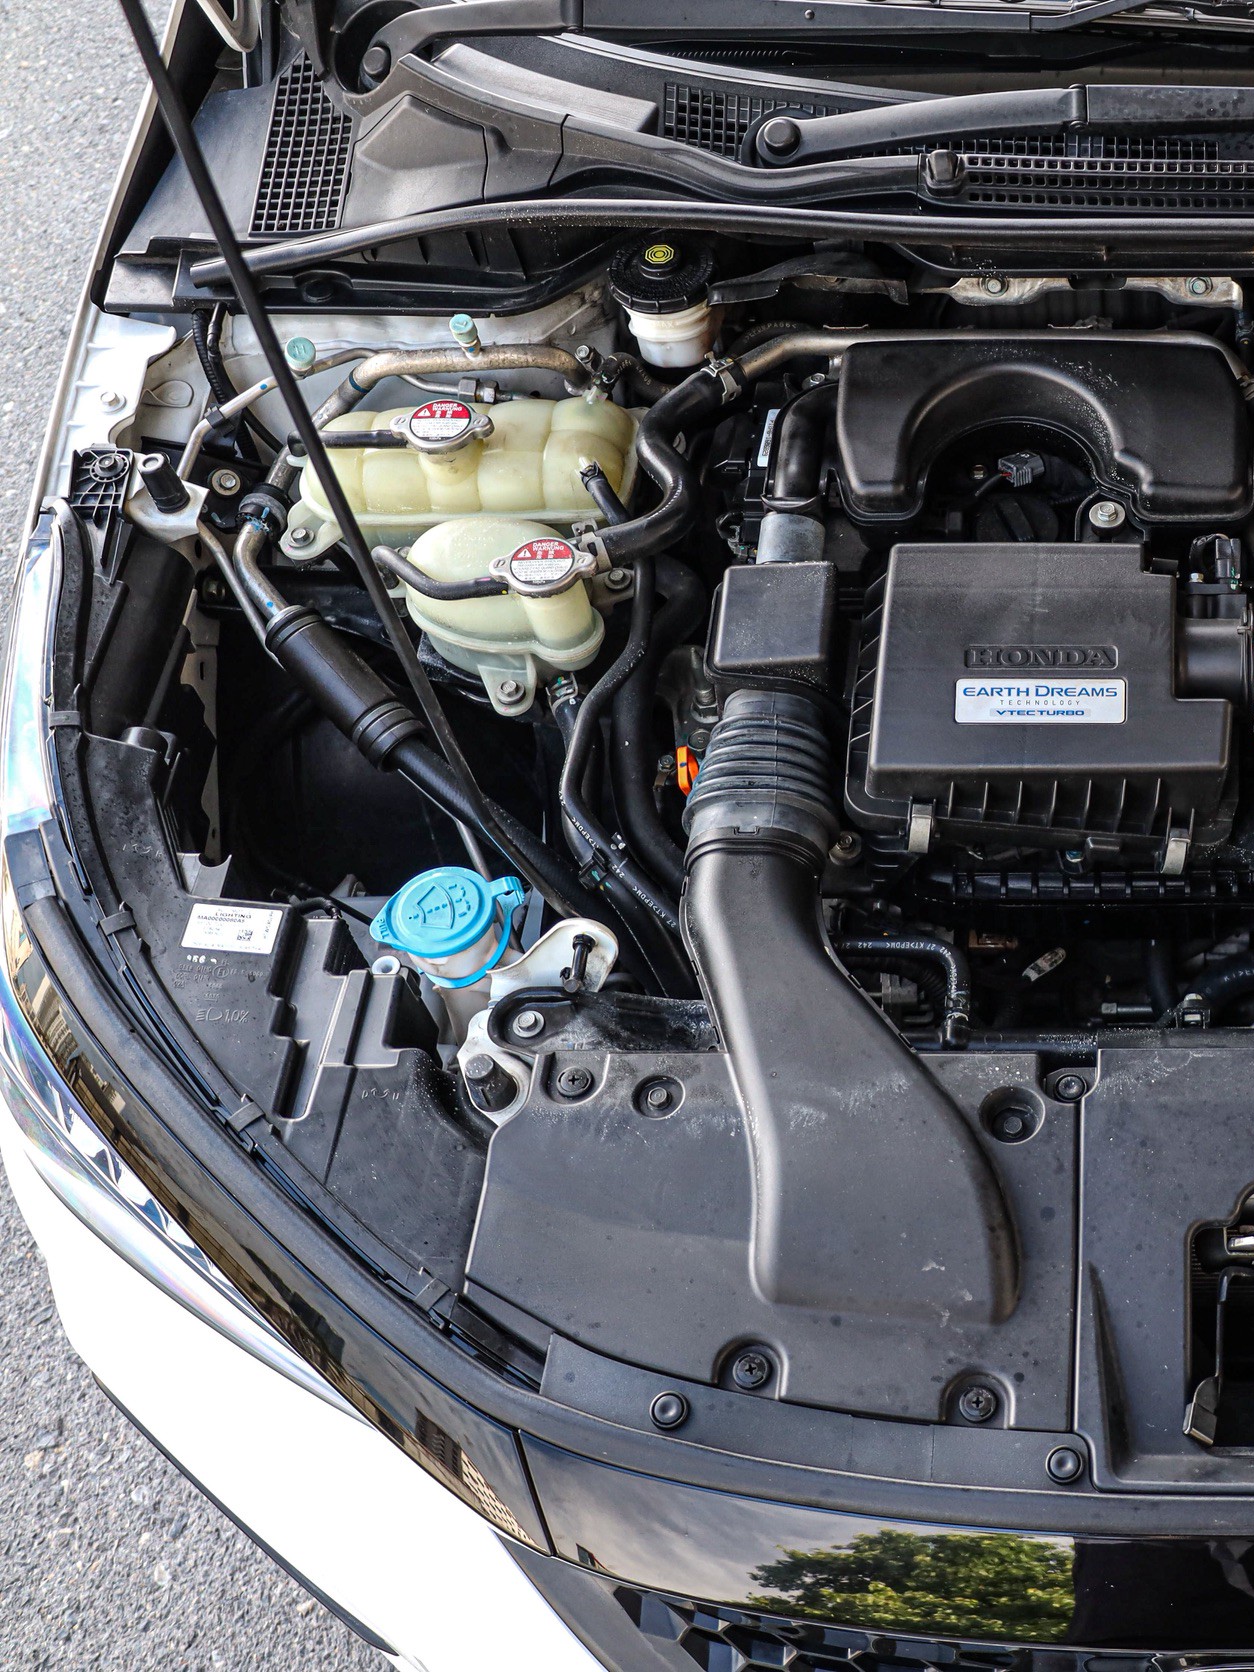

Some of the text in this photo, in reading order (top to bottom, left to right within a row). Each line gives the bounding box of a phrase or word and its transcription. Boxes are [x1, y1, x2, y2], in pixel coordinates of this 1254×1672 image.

[970, 648, 1116, 667] HONDA
[963, 685, 1118, 697] EARTH DREAMS
